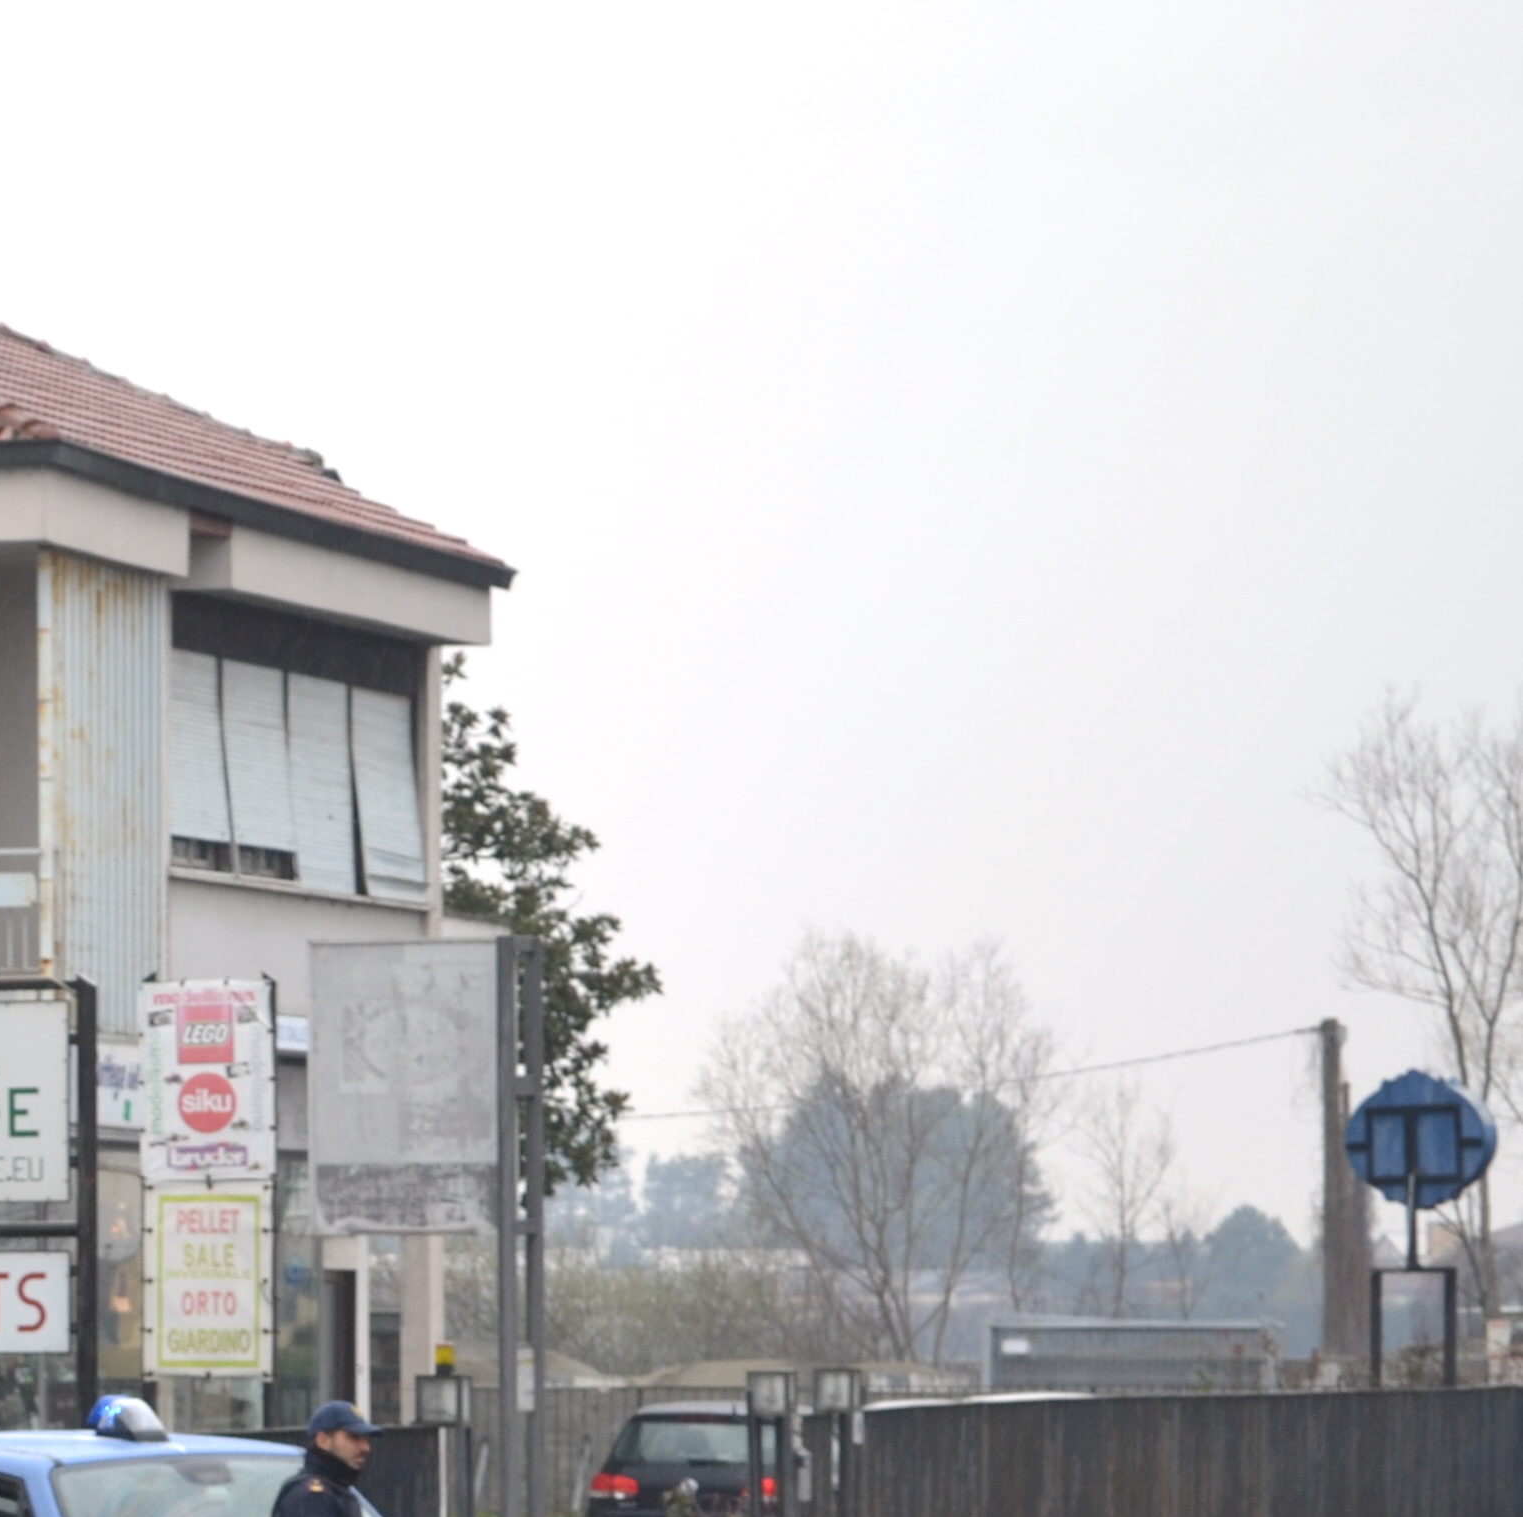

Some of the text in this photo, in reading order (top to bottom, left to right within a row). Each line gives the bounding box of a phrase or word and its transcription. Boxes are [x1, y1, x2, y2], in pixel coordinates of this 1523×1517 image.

[182, 1023, 230, 1044] LEGO
[181, 1088, 232, 1113] siku
[176, 1209, 241, 1234] PELLET
[184, 1243, 235, 1268] SALE
[181, 1291, 238, 1316] ORTO
[168, 1329, 251, 1353] GIARDINO
